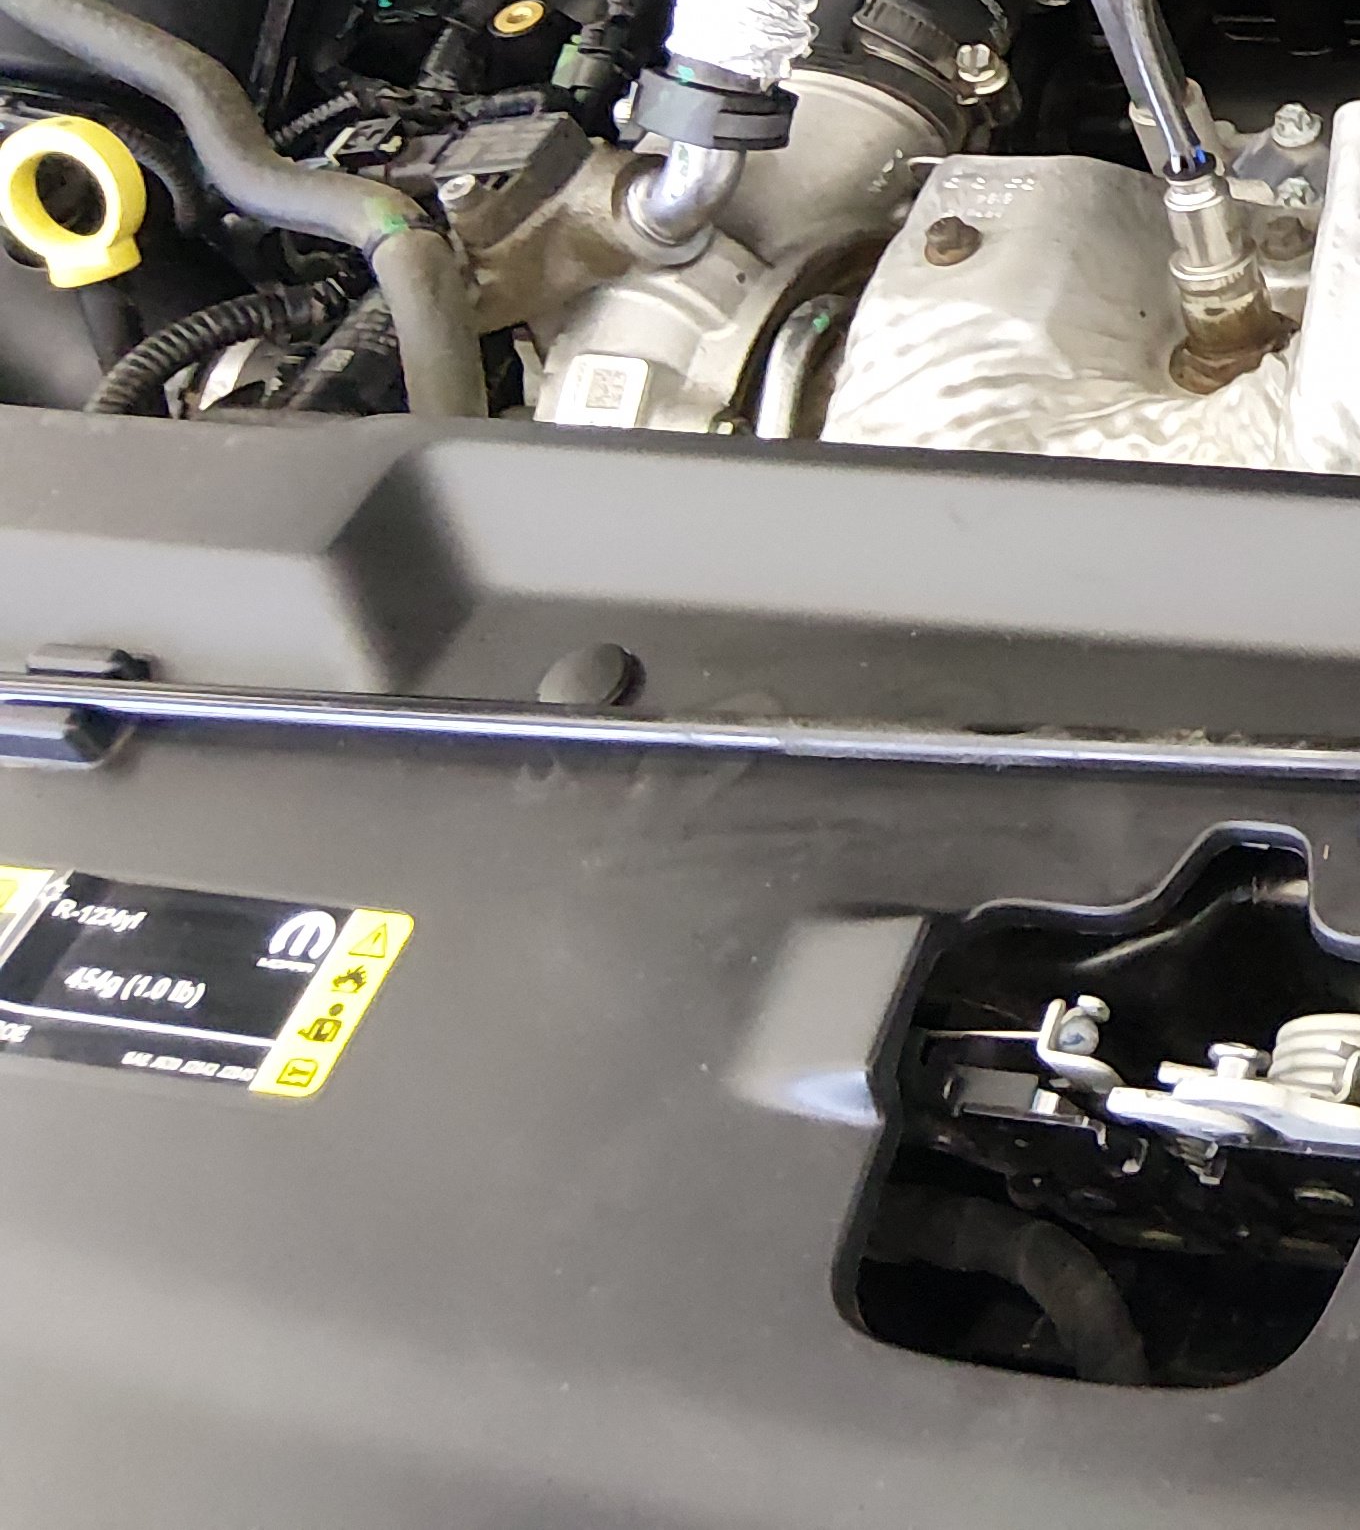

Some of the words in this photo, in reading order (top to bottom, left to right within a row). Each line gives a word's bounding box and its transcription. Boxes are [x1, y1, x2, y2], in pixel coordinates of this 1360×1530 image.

[52, 899, 148, 933] R-1234yf
[64, 966, 125, 999] 454g
[120, 973, 173, 1001] (1.0
